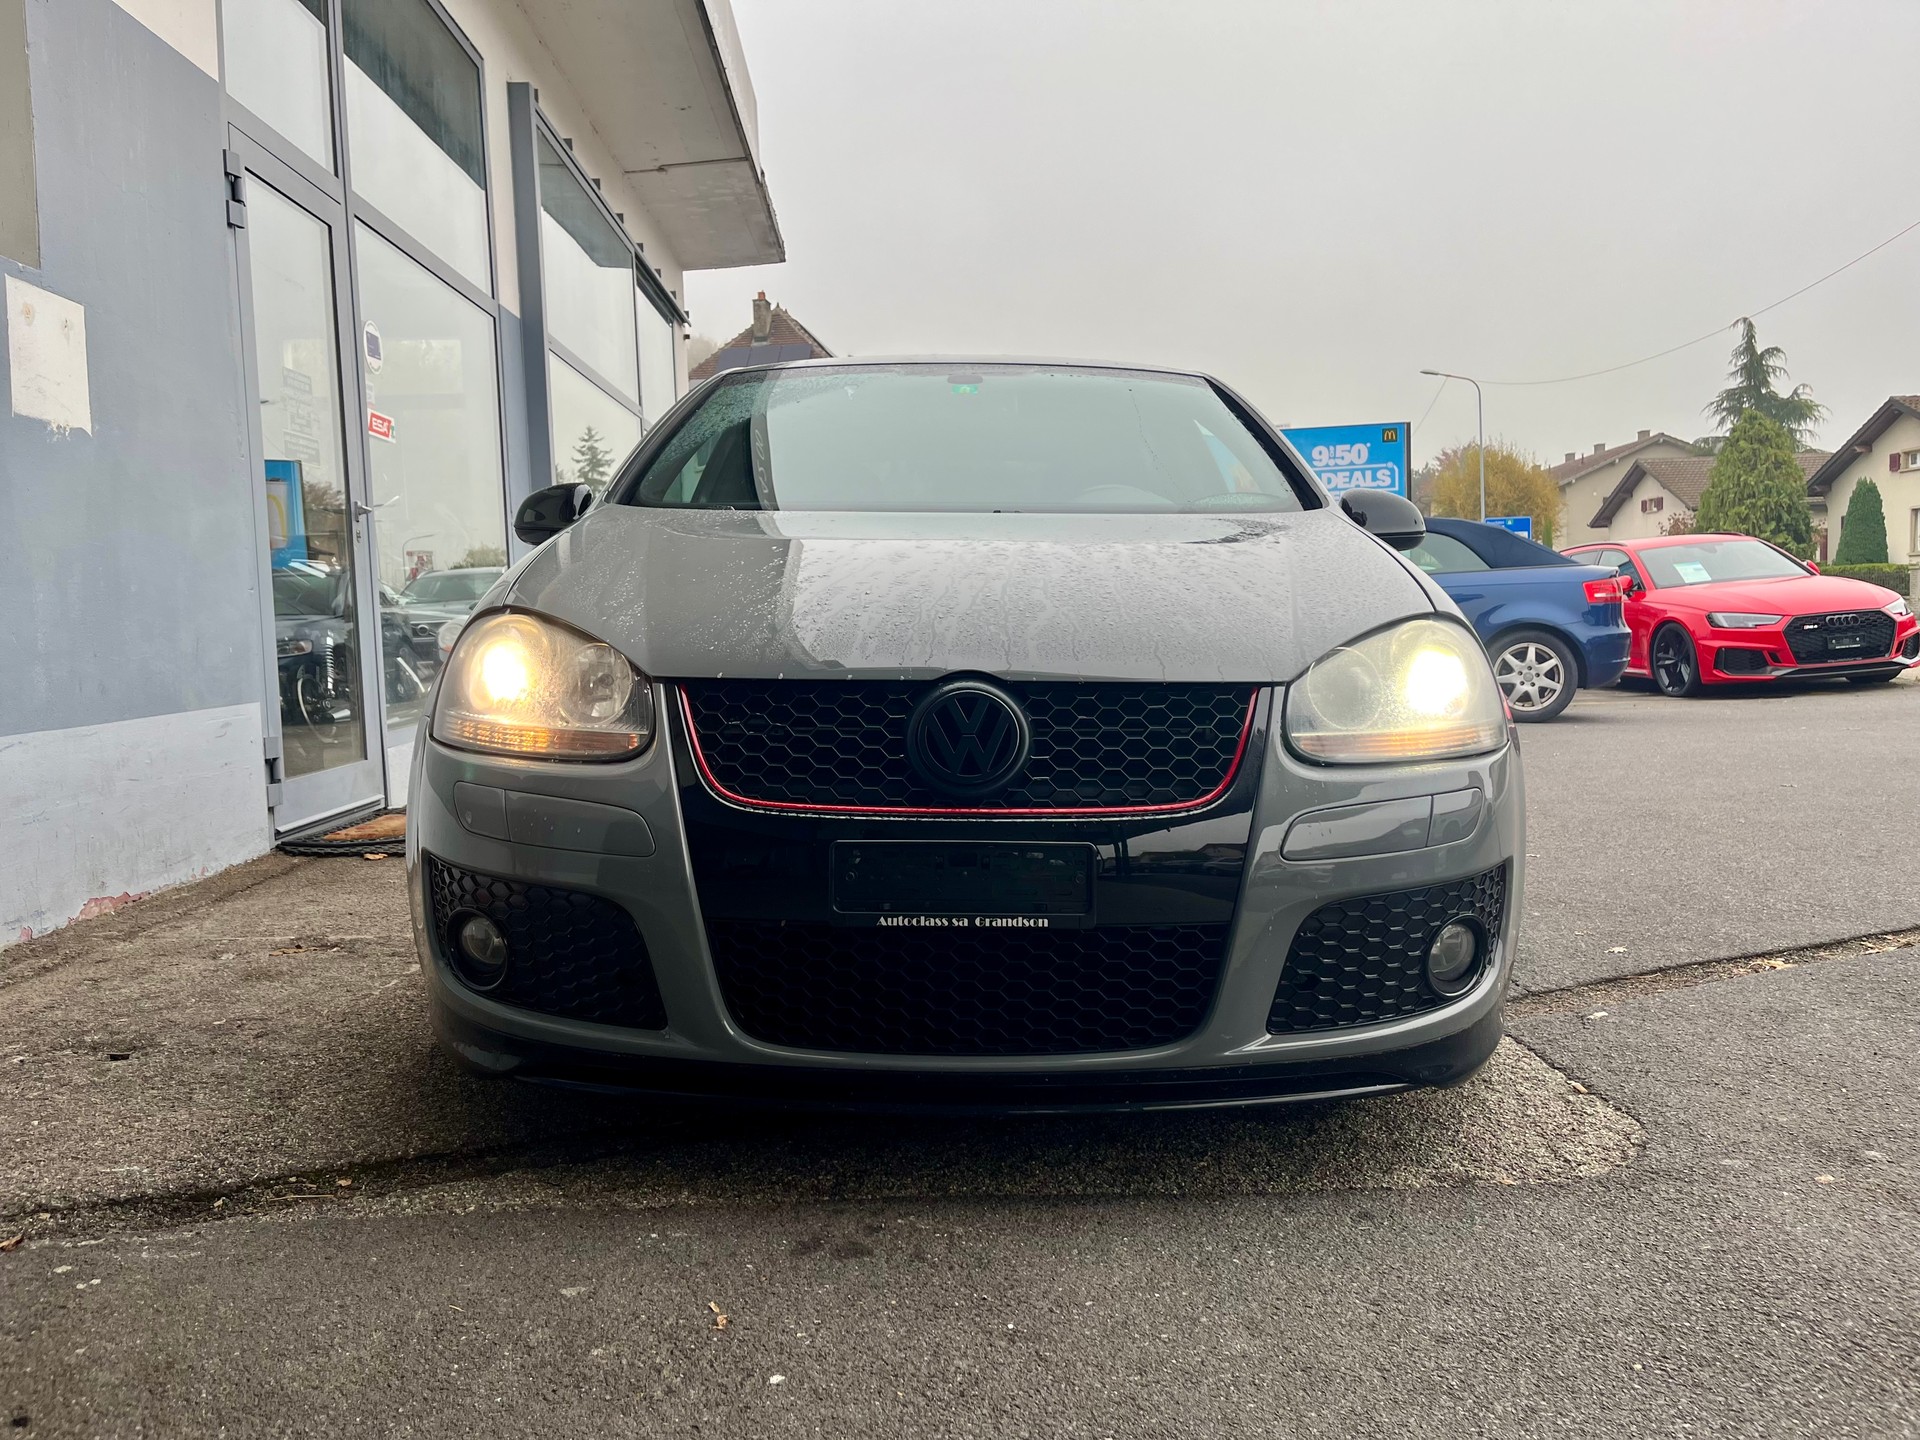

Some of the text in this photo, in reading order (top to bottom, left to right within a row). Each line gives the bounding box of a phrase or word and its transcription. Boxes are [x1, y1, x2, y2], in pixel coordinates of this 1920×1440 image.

[1321, 469, 1392, 489] DEALS
[876, 915, 1049, 928] Autoclass sa Grandson
